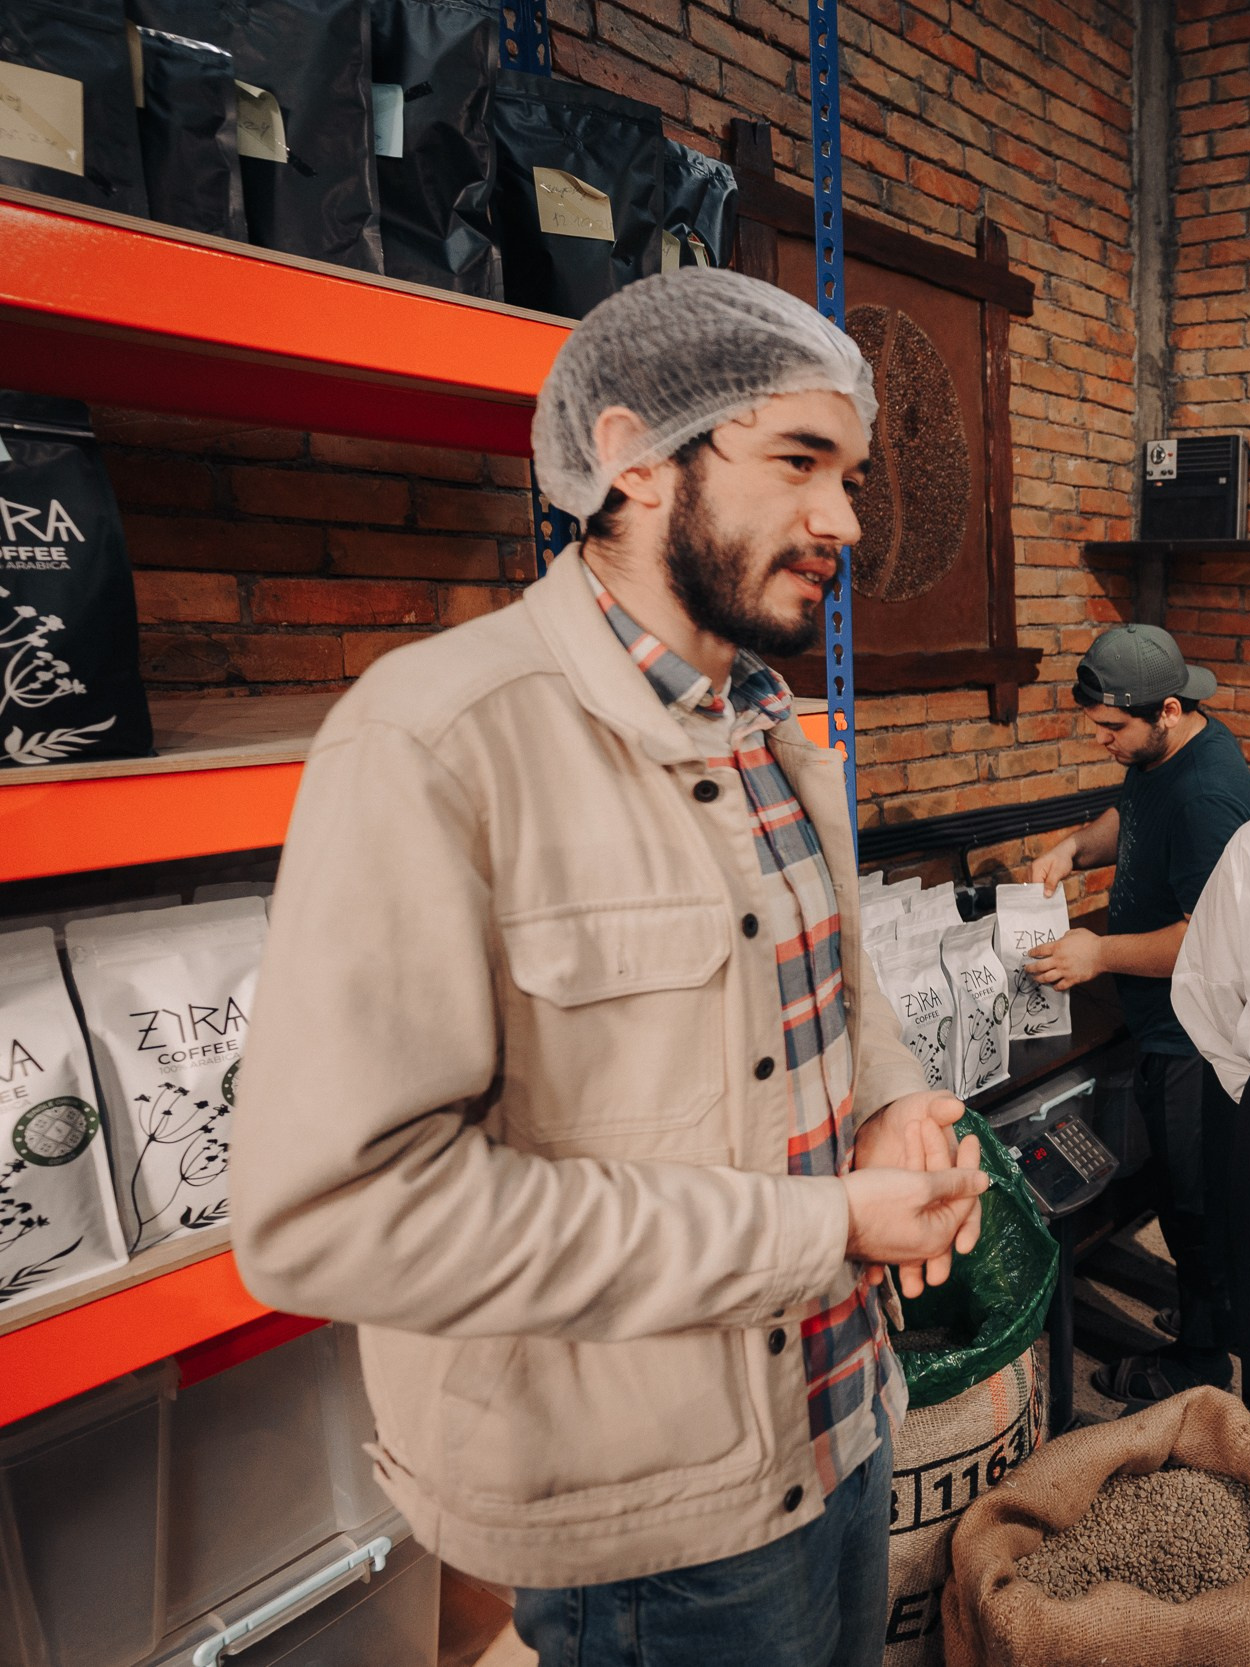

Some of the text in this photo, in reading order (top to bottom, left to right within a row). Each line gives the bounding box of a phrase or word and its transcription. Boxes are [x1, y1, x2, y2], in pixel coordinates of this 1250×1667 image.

[0, 496, 86, 542] RA
[0, 546, 69, 561] FFEE
[914, 1010, 940, 1025] COFFEE
[157, 1039, 240, 1065] COFFEE
[190, 1052, 241, 1068] ARABICA
